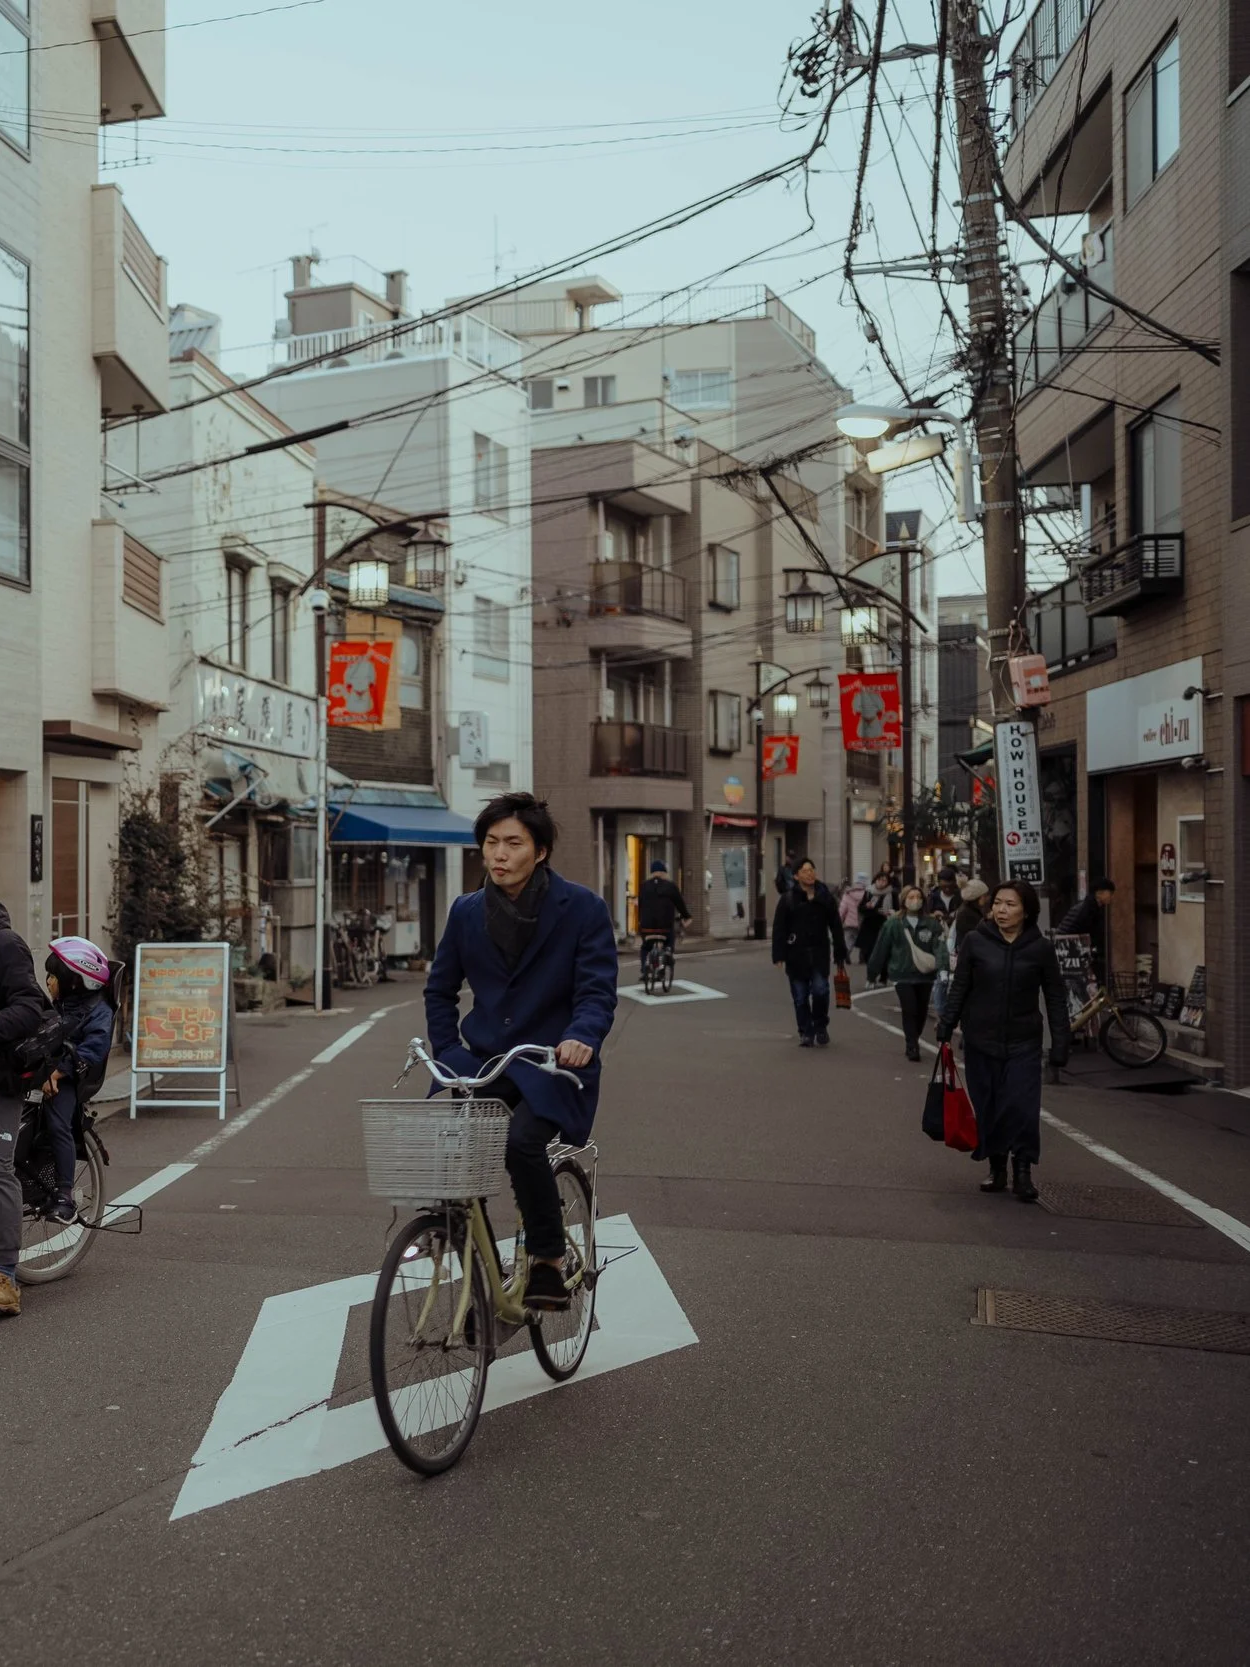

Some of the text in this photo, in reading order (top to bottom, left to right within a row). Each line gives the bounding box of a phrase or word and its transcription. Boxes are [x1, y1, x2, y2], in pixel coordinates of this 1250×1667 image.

[1010, 725, 1024, 760] HOW
[1013, 769, 1027, 830] HOUSE
[183, 1024, 215, 1042] 3F
